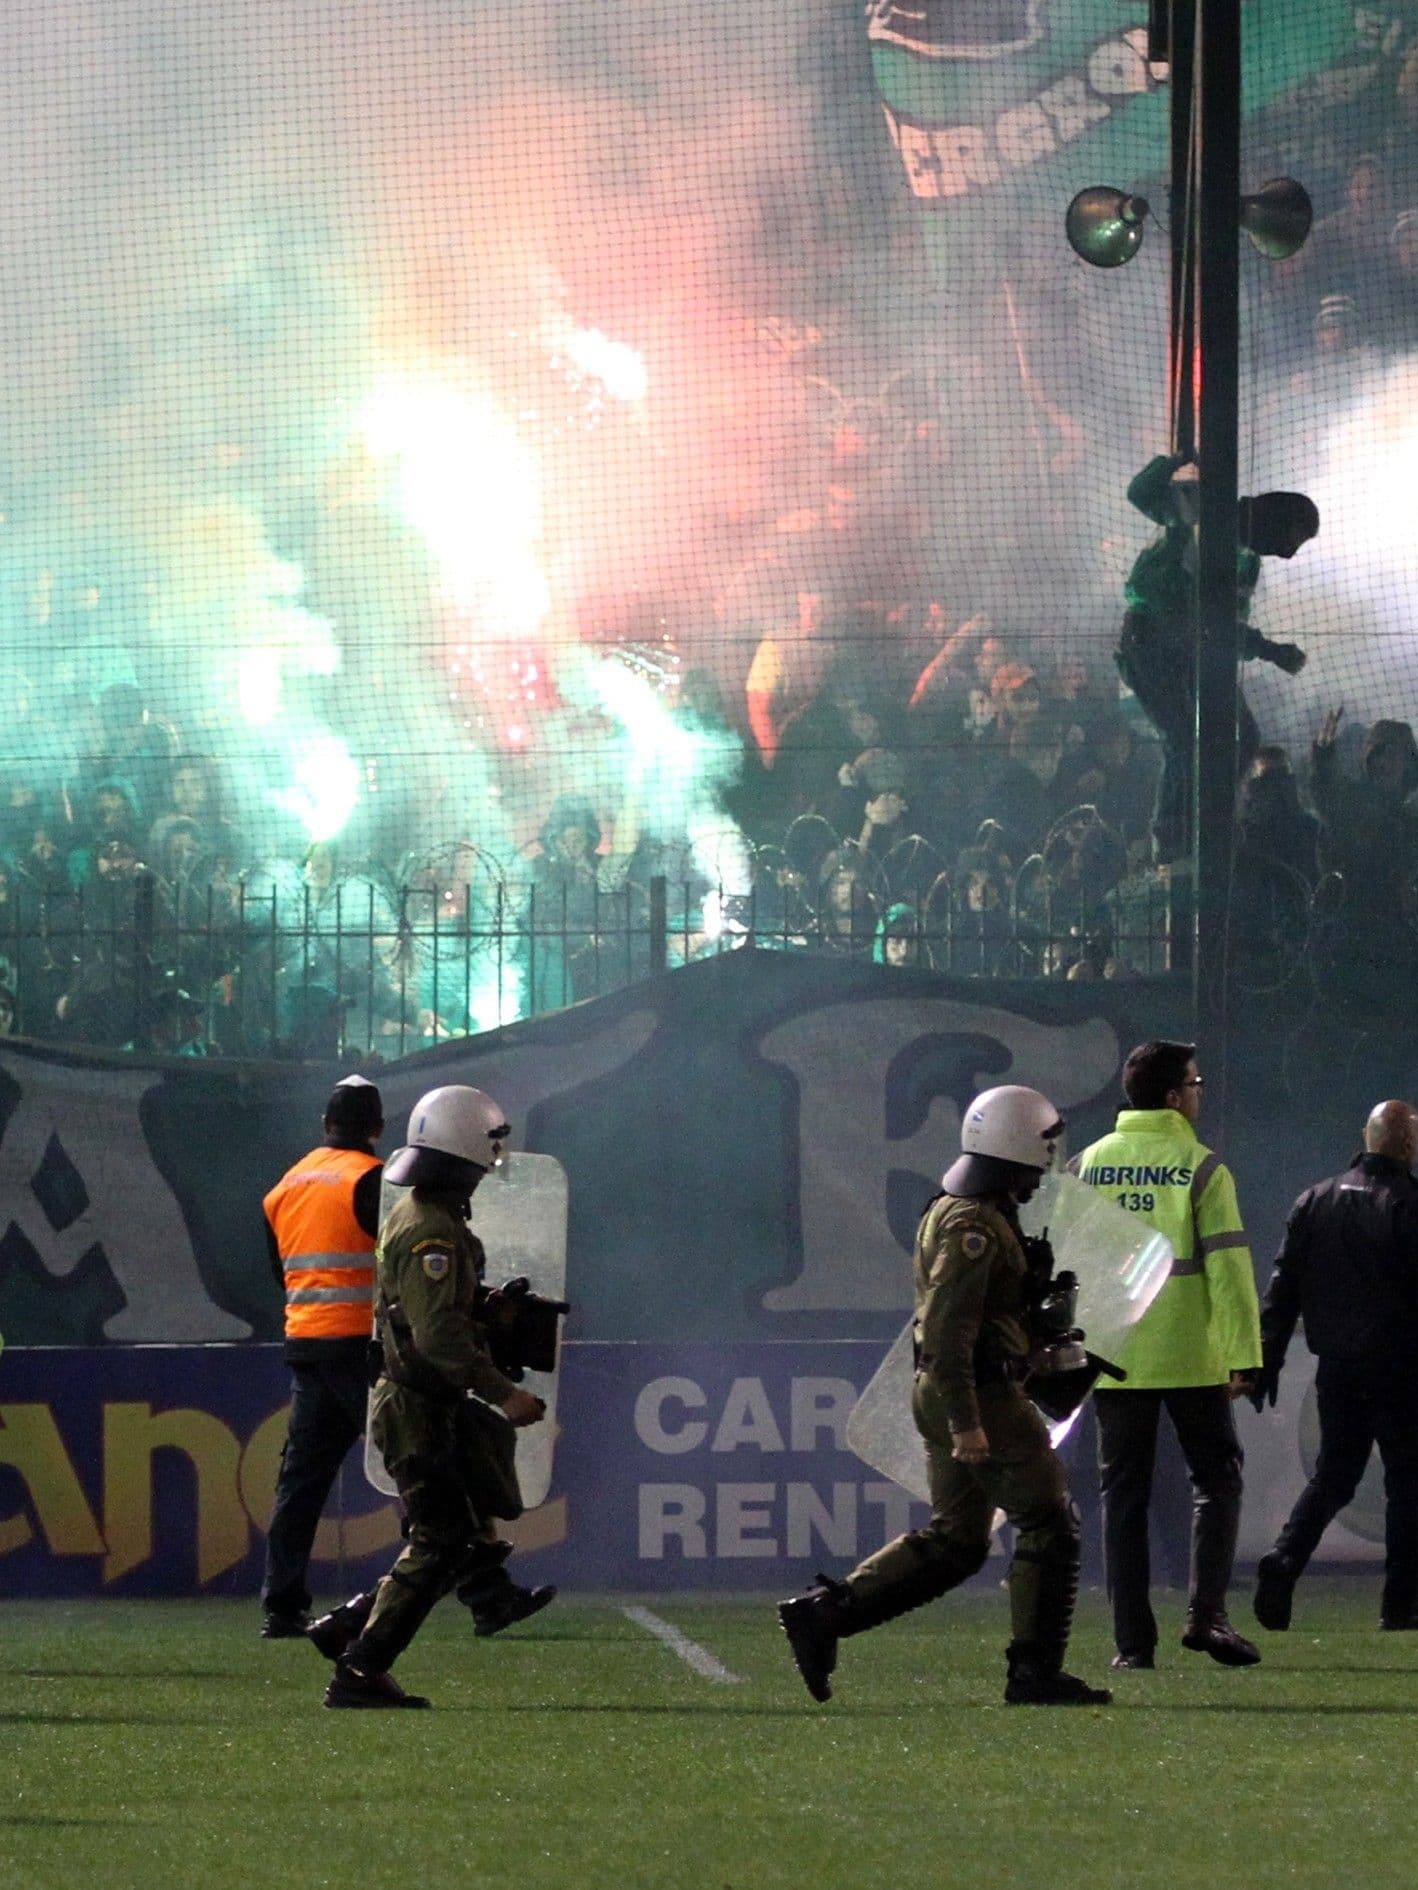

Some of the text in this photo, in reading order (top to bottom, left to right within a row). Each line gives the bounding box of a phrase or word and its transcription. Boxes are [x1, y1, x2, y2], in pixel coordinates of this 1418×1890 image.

[1100, 1166, 1193, 1186] BRINKS
[1117, 1192, 1155, 1212] 139
[633, 1376, 857, 1455] CAR
